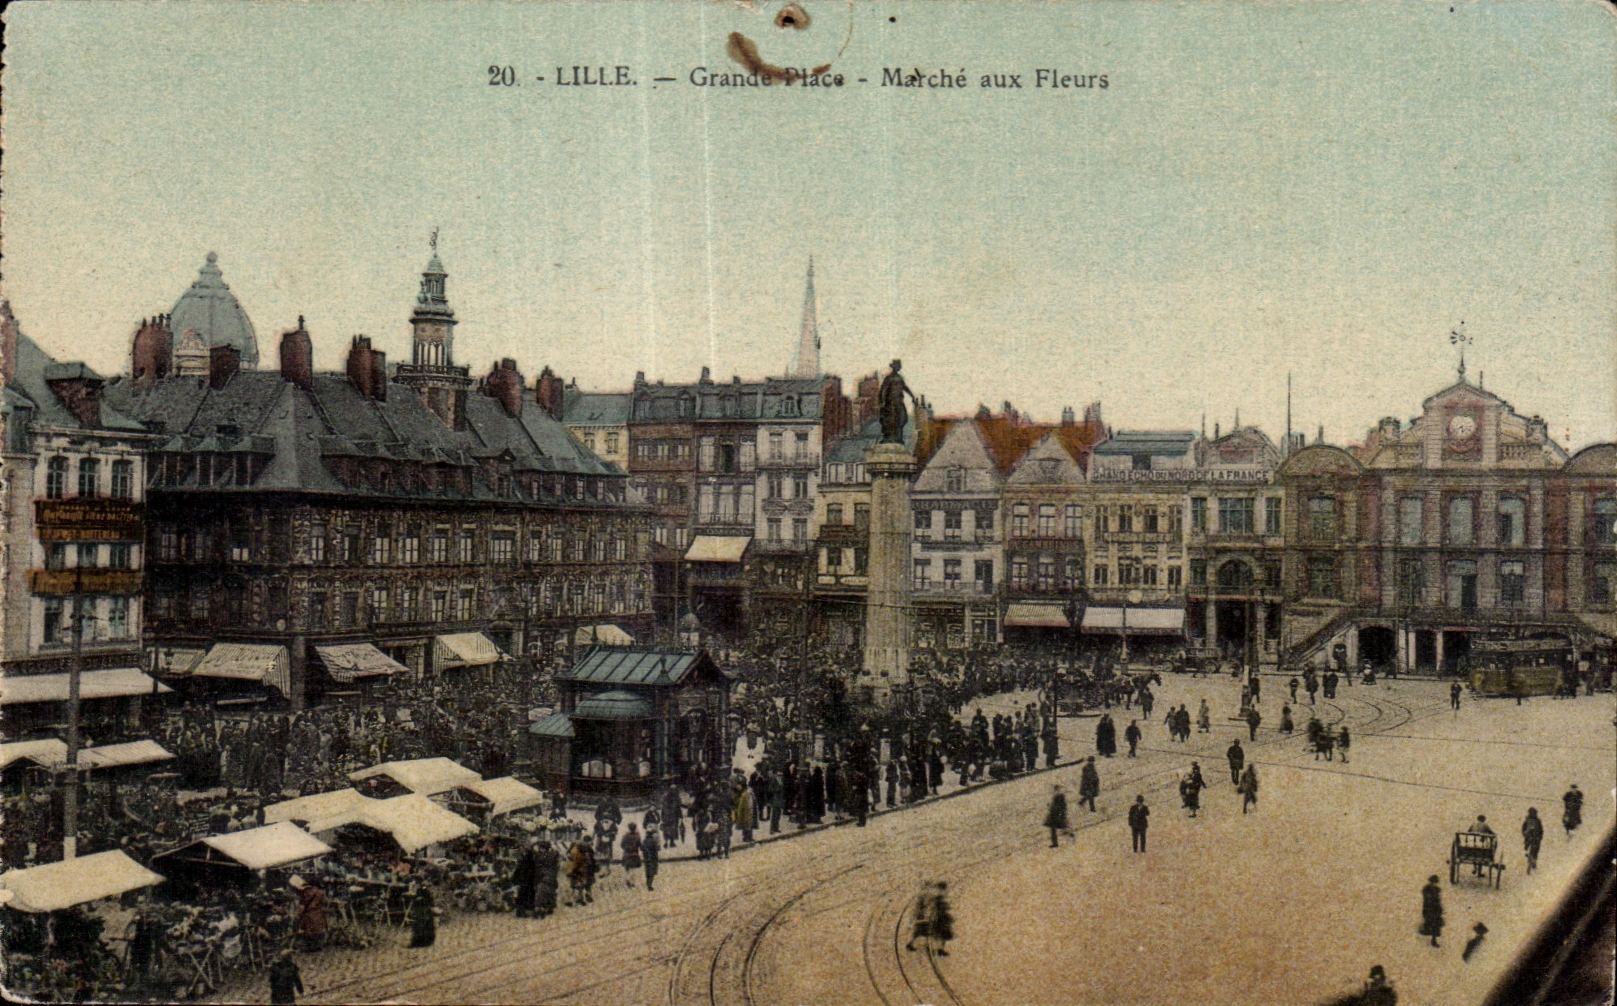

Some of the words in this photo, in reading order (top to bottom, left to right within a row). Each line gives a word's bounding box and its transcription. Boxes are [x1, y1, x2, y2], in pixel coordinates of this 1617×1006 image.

[1127, 470, 1155, 481] ECHO
[1210, 470, 1225, 481] LA
[1226, 470, 1269, 481] FRANCE
